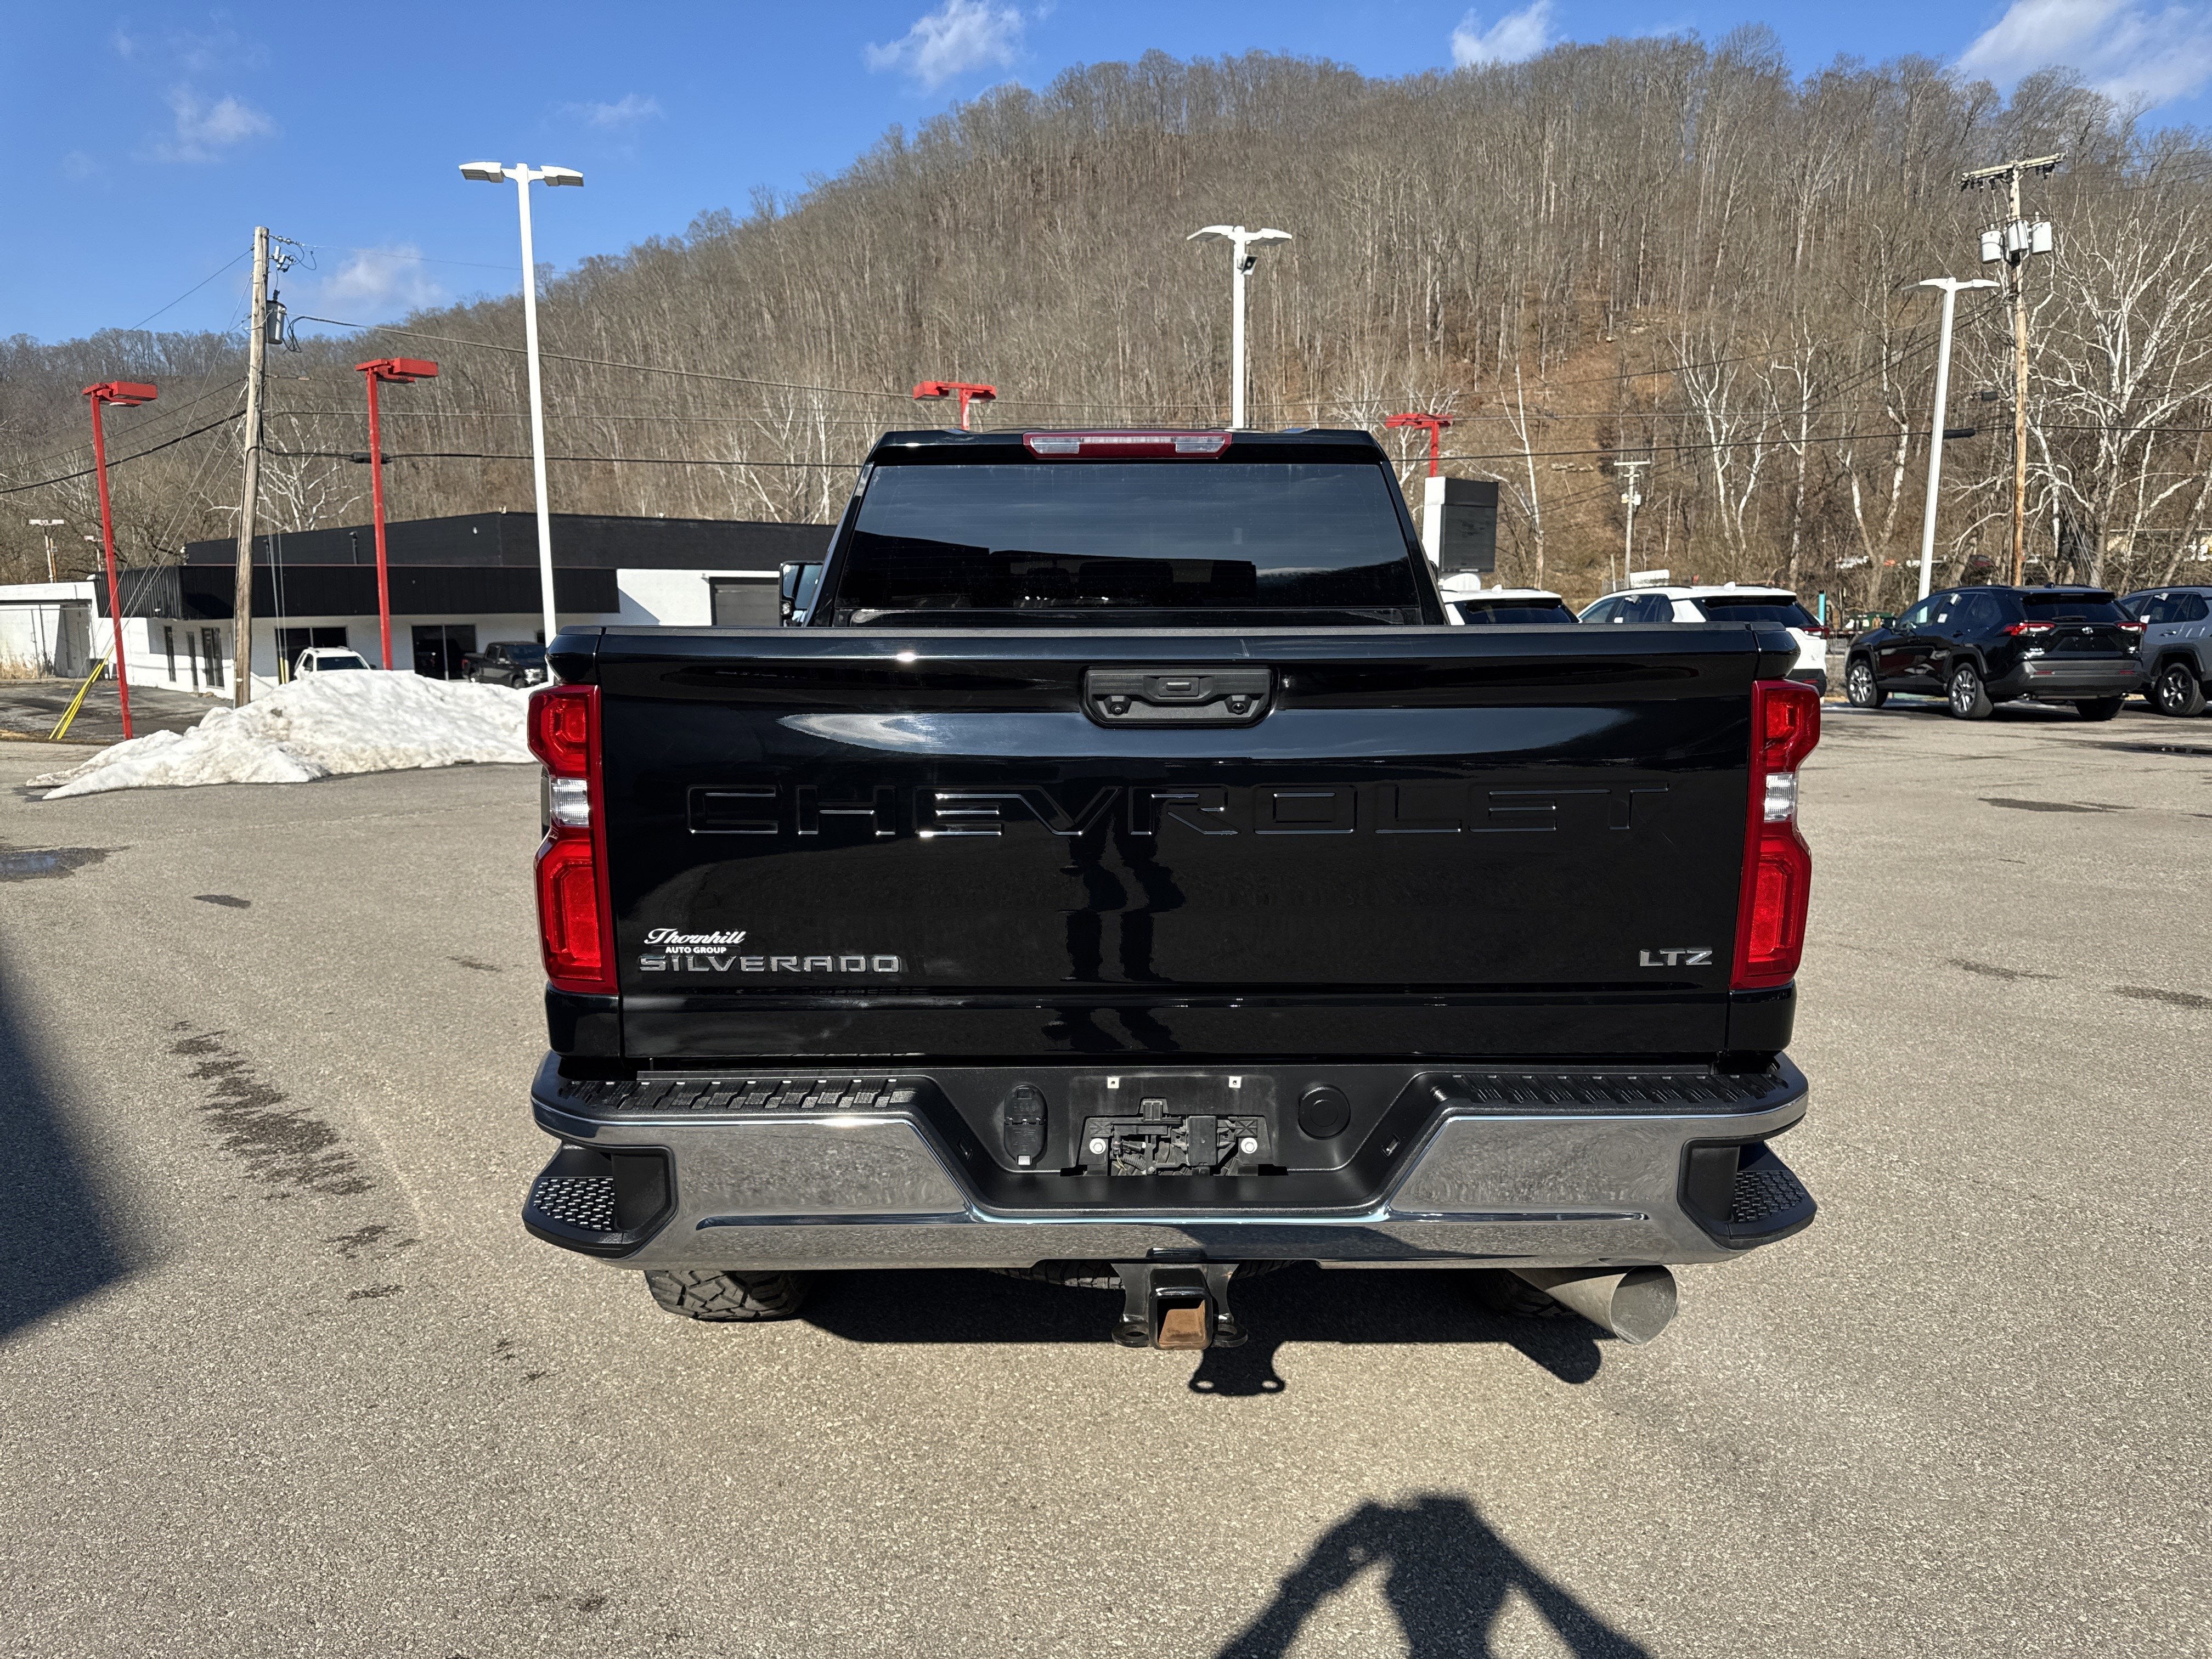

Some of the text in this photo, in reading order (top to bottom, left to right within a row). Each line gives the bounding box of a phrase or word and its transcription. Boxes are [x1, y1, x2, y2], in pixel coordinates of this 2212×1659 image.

[687, 781, 1670, 835] CHEVROLET
[644, 928, 746, 944] Thornhill
[639, 955, 901, 972] SILVERADO
[1639, 949, 1713, 967] LTZ
